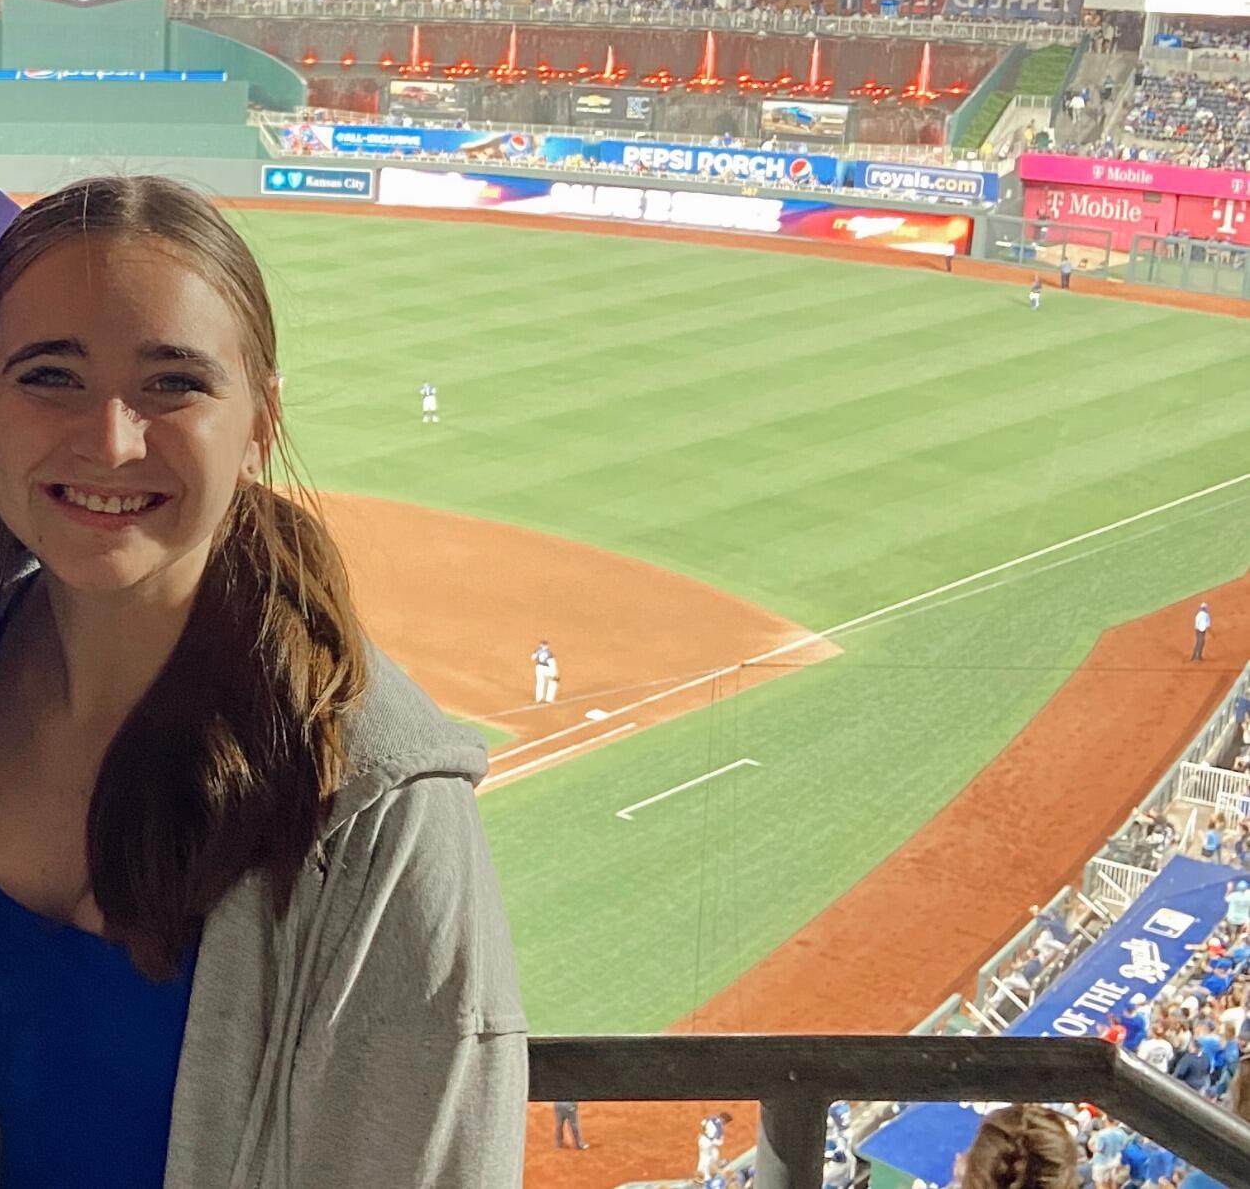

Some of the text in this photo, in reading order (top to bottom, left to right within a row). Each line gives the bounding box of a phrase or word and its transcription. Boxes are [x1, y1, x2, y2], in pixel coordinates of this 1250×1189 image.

[623, 145, 786, 179] PEPSI PORCH
[1107, 166, 1154, 184] Mobile
[306, 174, 366, 191] Kansas City
[871, 170, 977, 194] royals.com
[1069, 192, 1142, 222] Mobile
[1053, 977, 1130, 1037] OF THE
